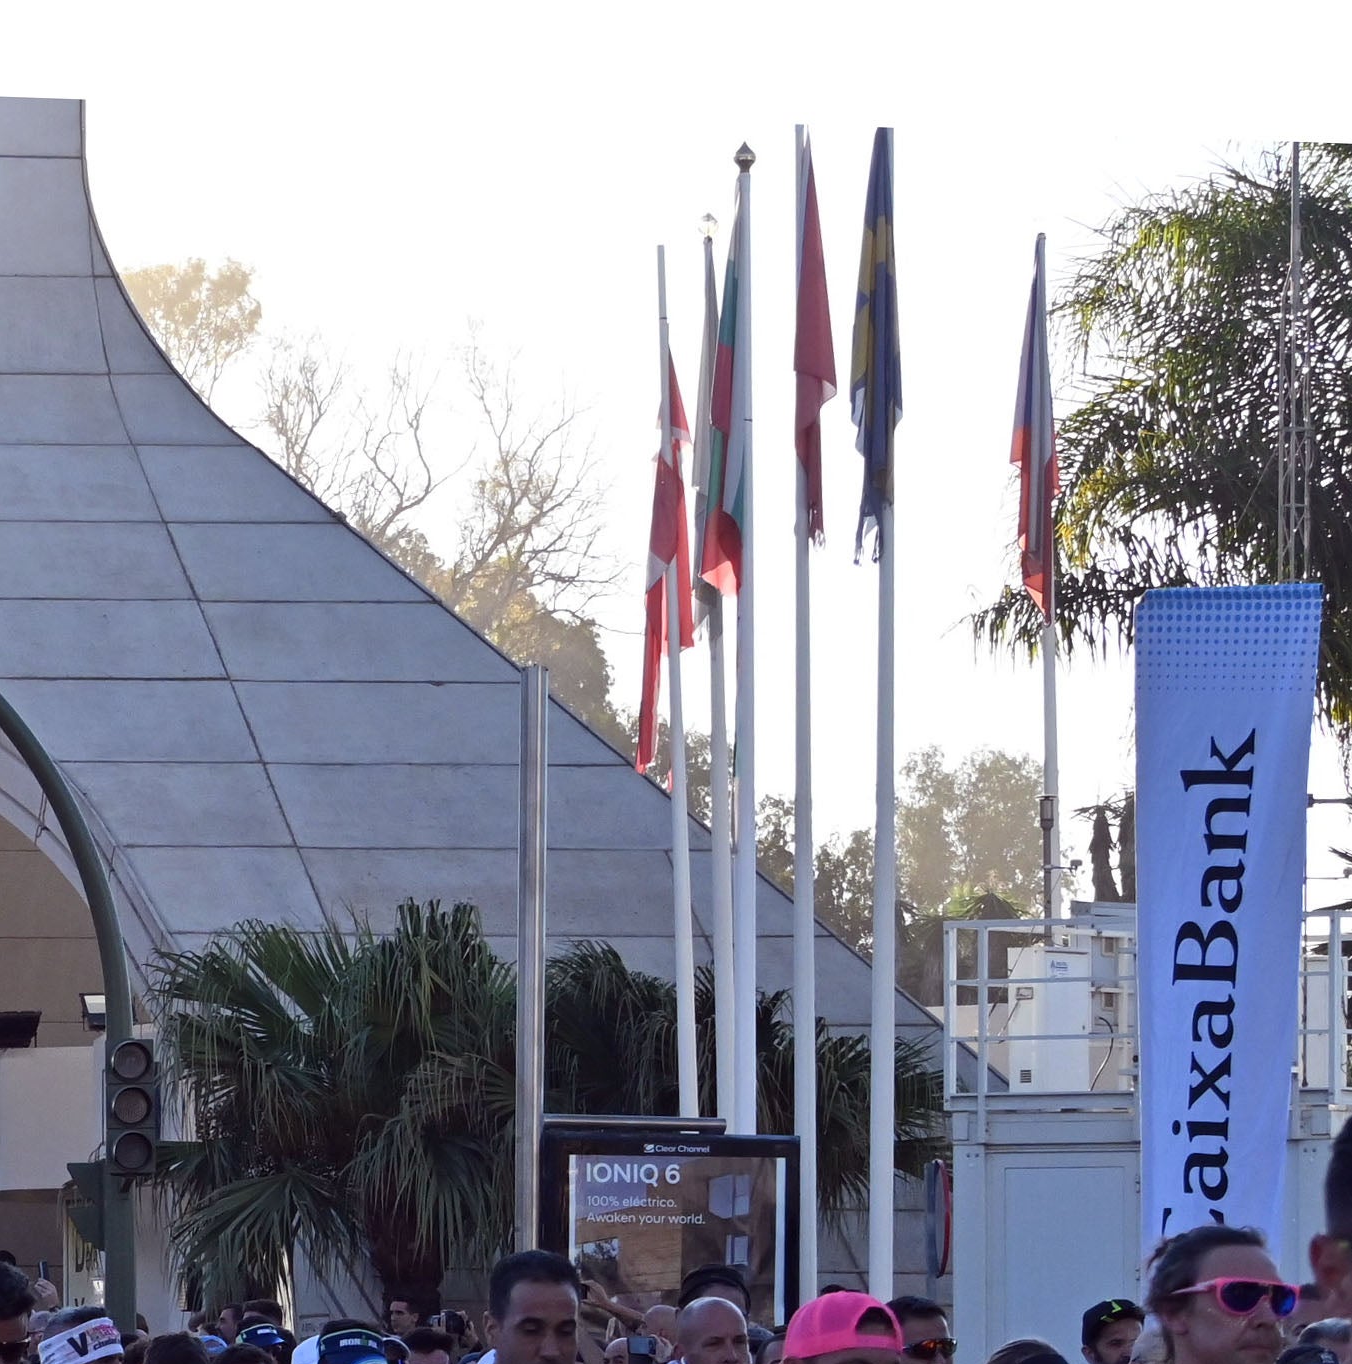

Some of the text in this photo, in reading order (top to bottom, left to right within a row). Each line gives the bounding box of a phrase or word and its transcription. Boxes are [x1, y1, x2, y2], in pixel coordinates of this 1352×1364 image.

[655, 1144, 710, 1153] Clear Channel
[585, 1162, 681, 1187] IONIQ 6
[586, 1195, 677, 1208] 100% eléctrico.
[586, 1213, 706, 1225] Awaken your world.
